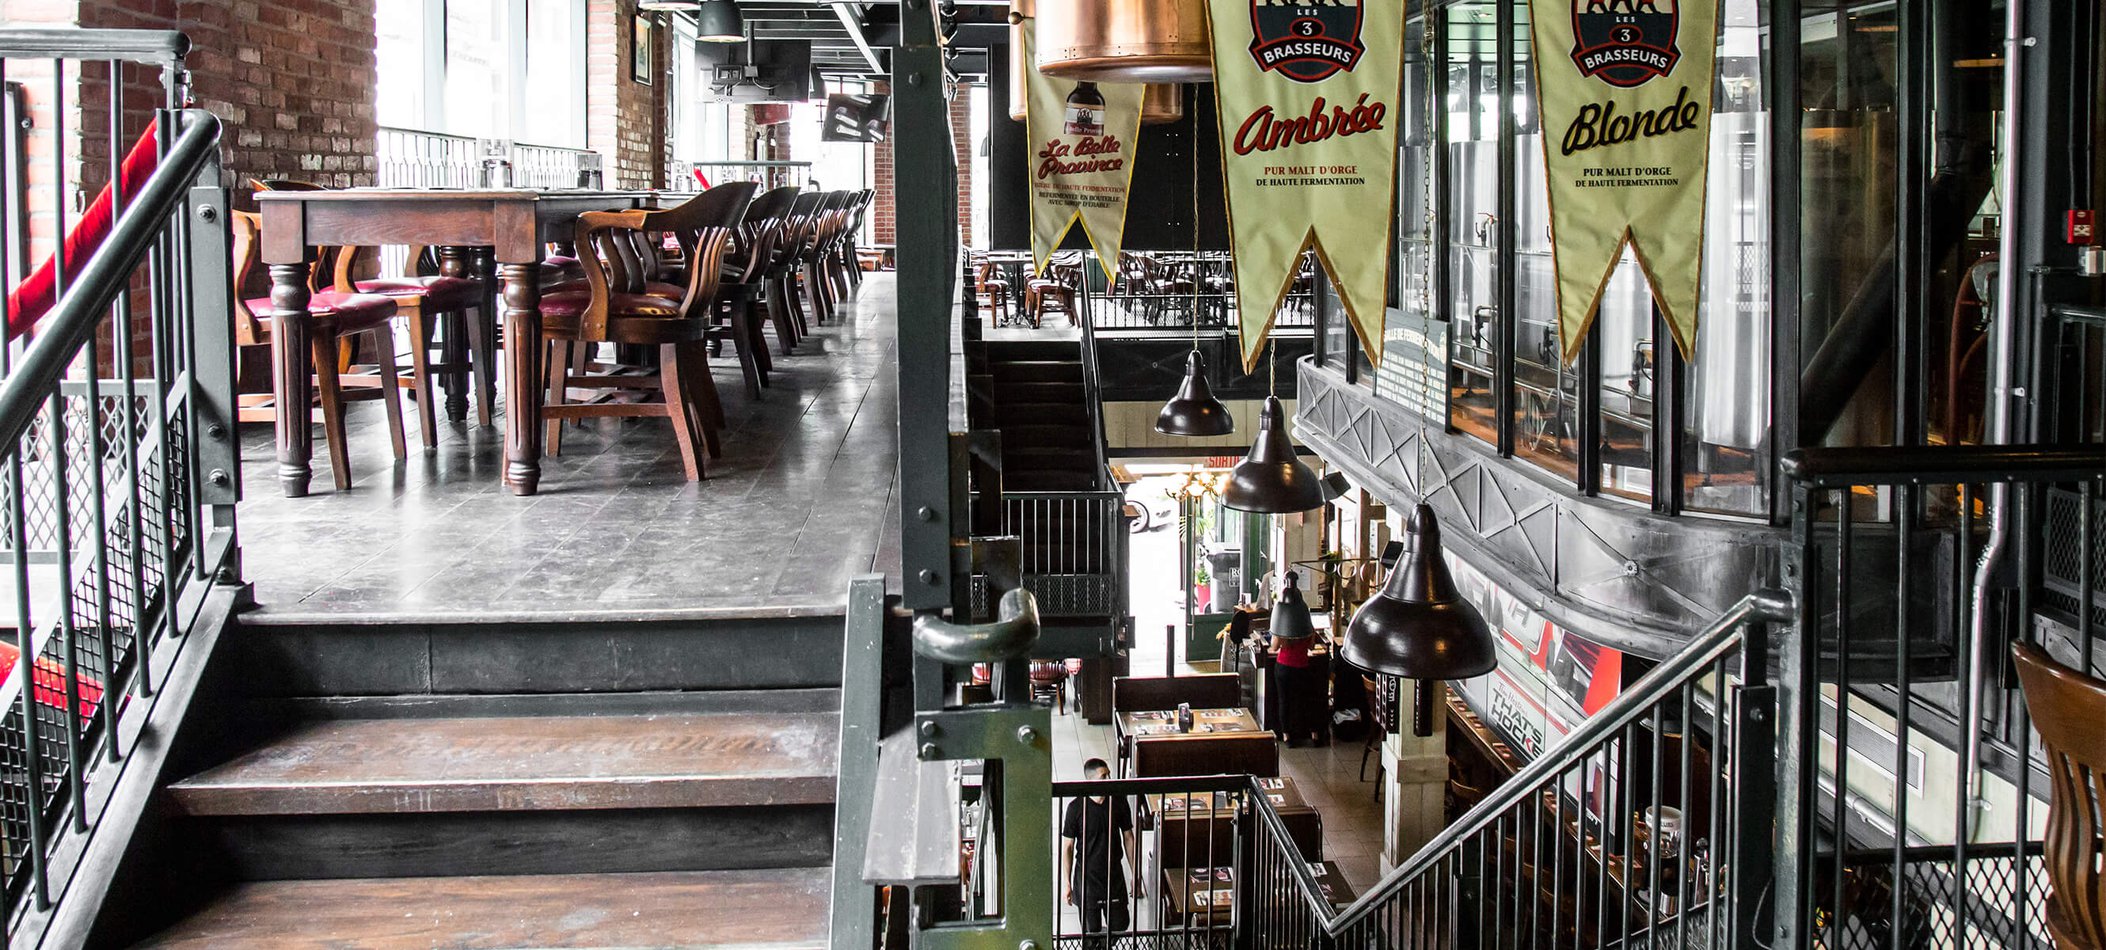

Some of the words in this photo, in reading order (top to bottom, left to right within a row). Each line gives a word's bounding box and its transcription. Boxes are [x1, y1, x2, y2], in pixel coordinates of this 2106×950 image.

[1302, 22, 1313, 36] 3
[1620, 29, 1631, 42] 3
[1263, 42, 1352, 63] BRASSEURS
[1584, 49, 1668, 69] BRASSEURS
[1233, 92, 1386, 156] Ambrée
[1561, 86, 1699, 156] Blonde
[1039, 139, 1070, 158] La
[1074, 135, 1121, 157] Belle
[1038, 154, 1123, 180] Province
[1264, 166, 1285, 175] PUR
[1288, 166, 1315, 175] MALT
[1319, 166, 1358, 175] D'ORGE
[1583, 168, 1603, 177] PUR
[1606, 168, 1631, 176] MALT
[1635, 167, 1672, 176] D'ORGE
[1256, 179, 1268, 187] DE
[1270, 178, 1299, 186] HAUTE
[1301, 177, 1365, 186] FERMENTATION
[1575, 180, 1586, 188] DE
[1588, 179, 1616, 187] HAUTE
[1618, 178, 1679, 187] FERMENTATION
[1209, 456, 1240, 468] SORTI
[1493, 688, 1543, 745] THAT'S
[1491, 703, 1545, 759] HOCKE
